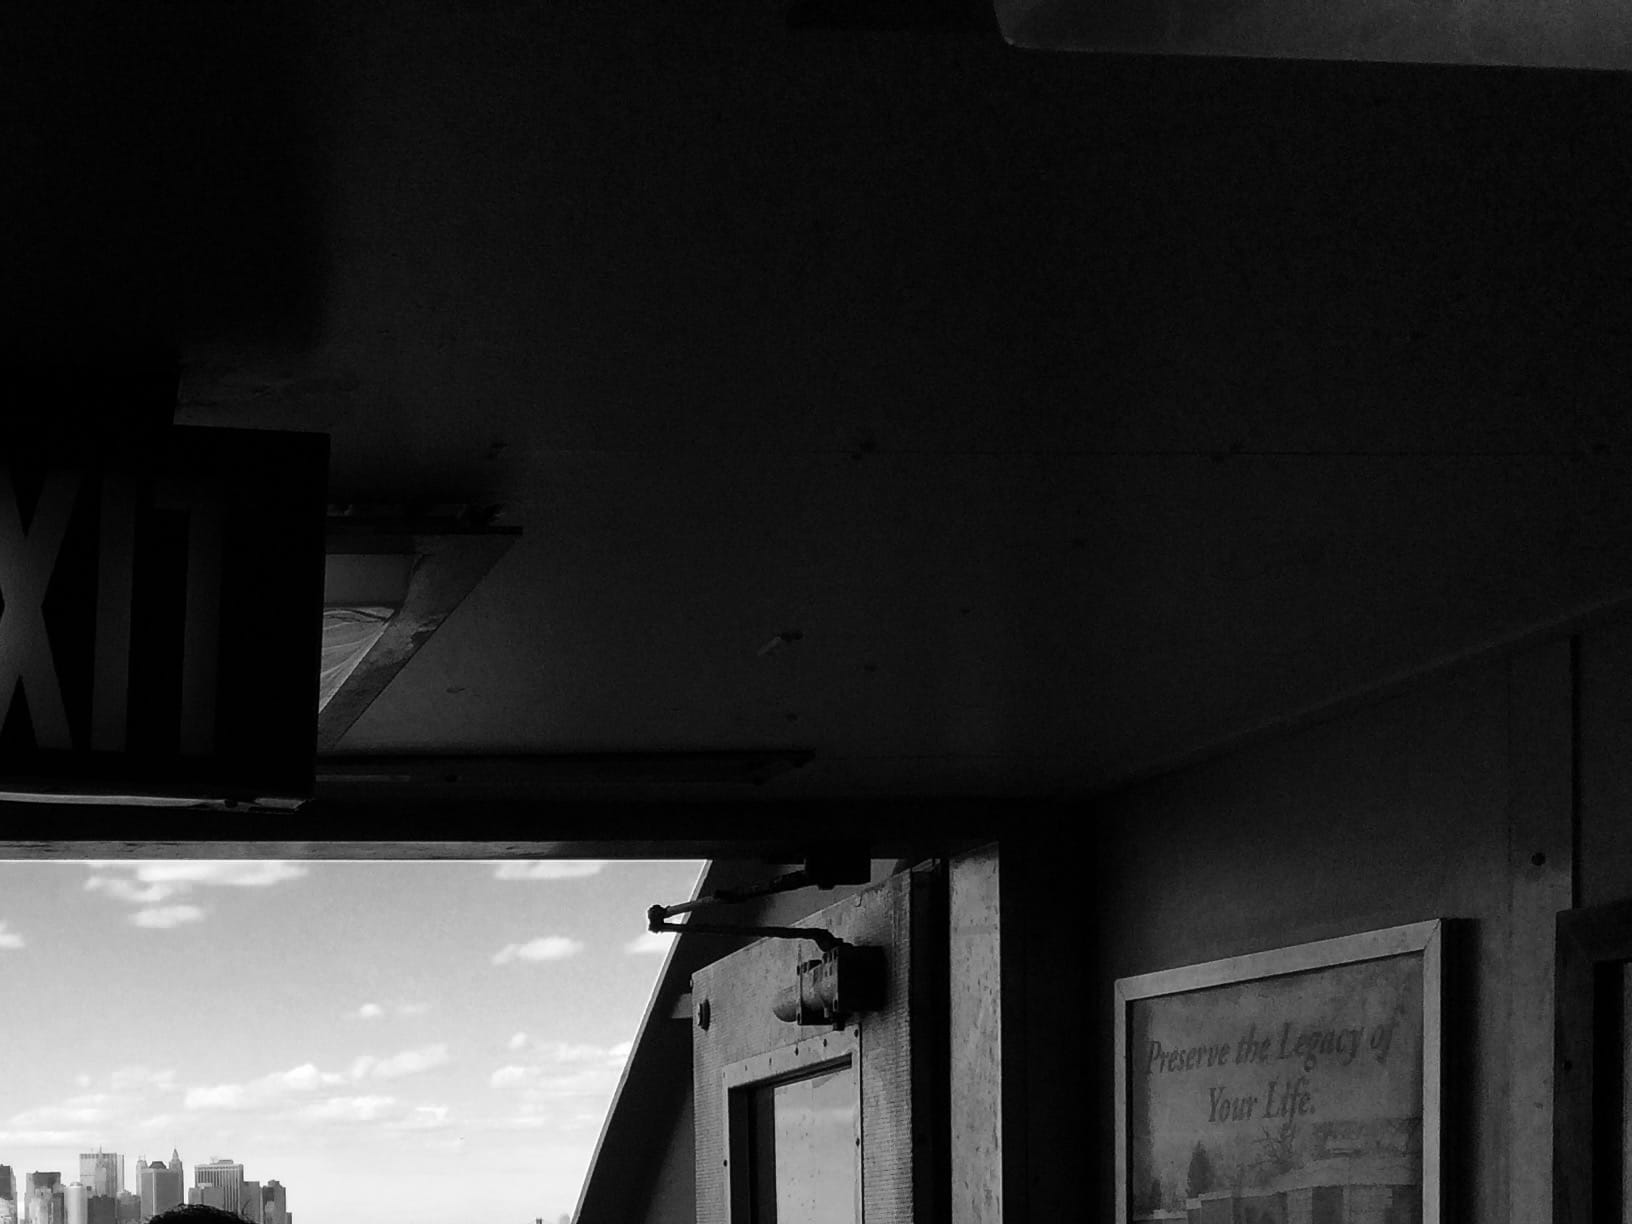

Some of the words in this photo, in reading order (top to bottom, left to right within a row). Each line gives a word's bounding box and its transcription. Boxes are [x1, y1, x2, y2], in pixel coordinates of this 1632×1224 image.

[1149, 1040, 1228, 1074] Preserve
[1235, 1022, 1271, 1065] the
[1279, 1022, 1365, 1072] Legacy
[1370, 1020, 1401, 1065] of
[1208, 1087, 1258, 1123] Your
[1263, 1077, 1317, 1131] Life.
